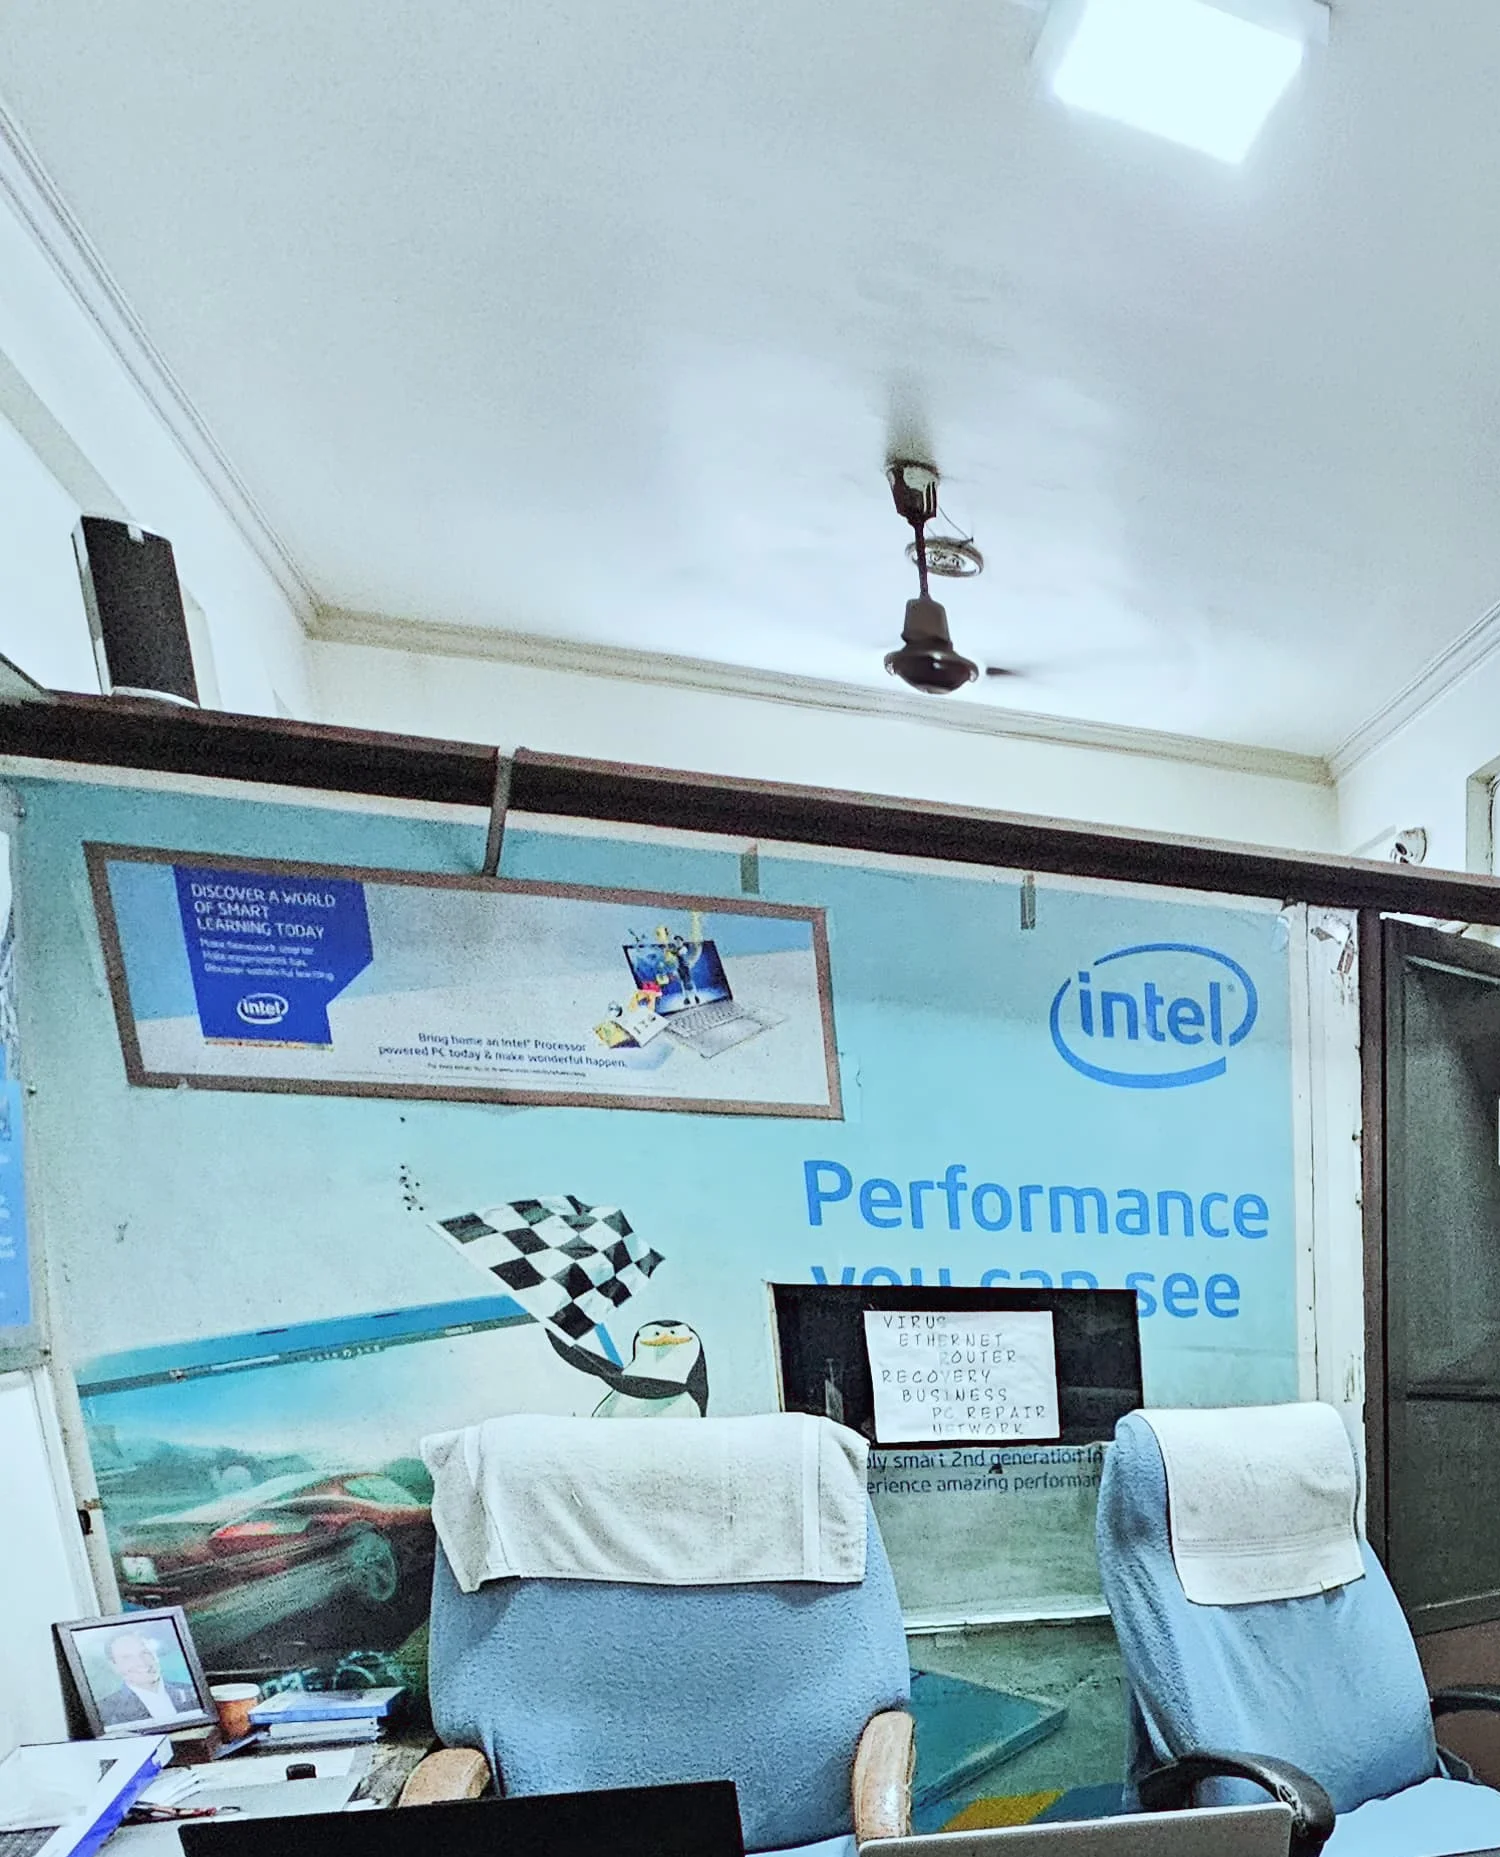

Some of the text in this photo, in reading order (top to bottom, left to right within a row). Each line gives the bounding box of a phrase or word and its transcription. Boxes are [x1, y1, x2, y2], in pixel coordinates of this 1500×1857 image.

[191, 884, 336, 908] DISCOVER A WORLD
[194, 901, 270, 919] OF SMART
[196, 918, 324, 940] LEARNING TODAY
[242, 998, 281, 1017] intel
[1079, 971, 1223, 1046] intel
[418, 1032, 449, 1046] Bring
[451, 1035, 481, 1046] home
[487, 1038, 499, 1047] an
[534, 1039, 586, 1052] Processor
[378, 1046, 429, 1058] powered
[431, 1047, 445, 1058] PC
[449, 1048, 481, 1061] today
[484, 1050, 493, 1060] &
[495, 1051, 525, 1062] make
[528, 1053, 583, 1066] wonderful
[804, 1160, 1269, 1239] Performance
[1125, 1271, 1241, 1318] see
[884, 1315, 947, 1329] VIRUS
[900, 1333, 1004, 1347] ETHERNET
[939, 1350, 1017, 1366] ROUTER
[882, 1369, 992, 1384] RECOVERY
[903, 1388, 1008, 1402] BUSINESS
[932, 1405, 1046, 1420] PC REPAIR
[932, 1423, 1025, 1436] NETWORK
[952, 1450, 985, 1468] 2nd
[867, 1471, 1102, 1494] erience amazing performan
